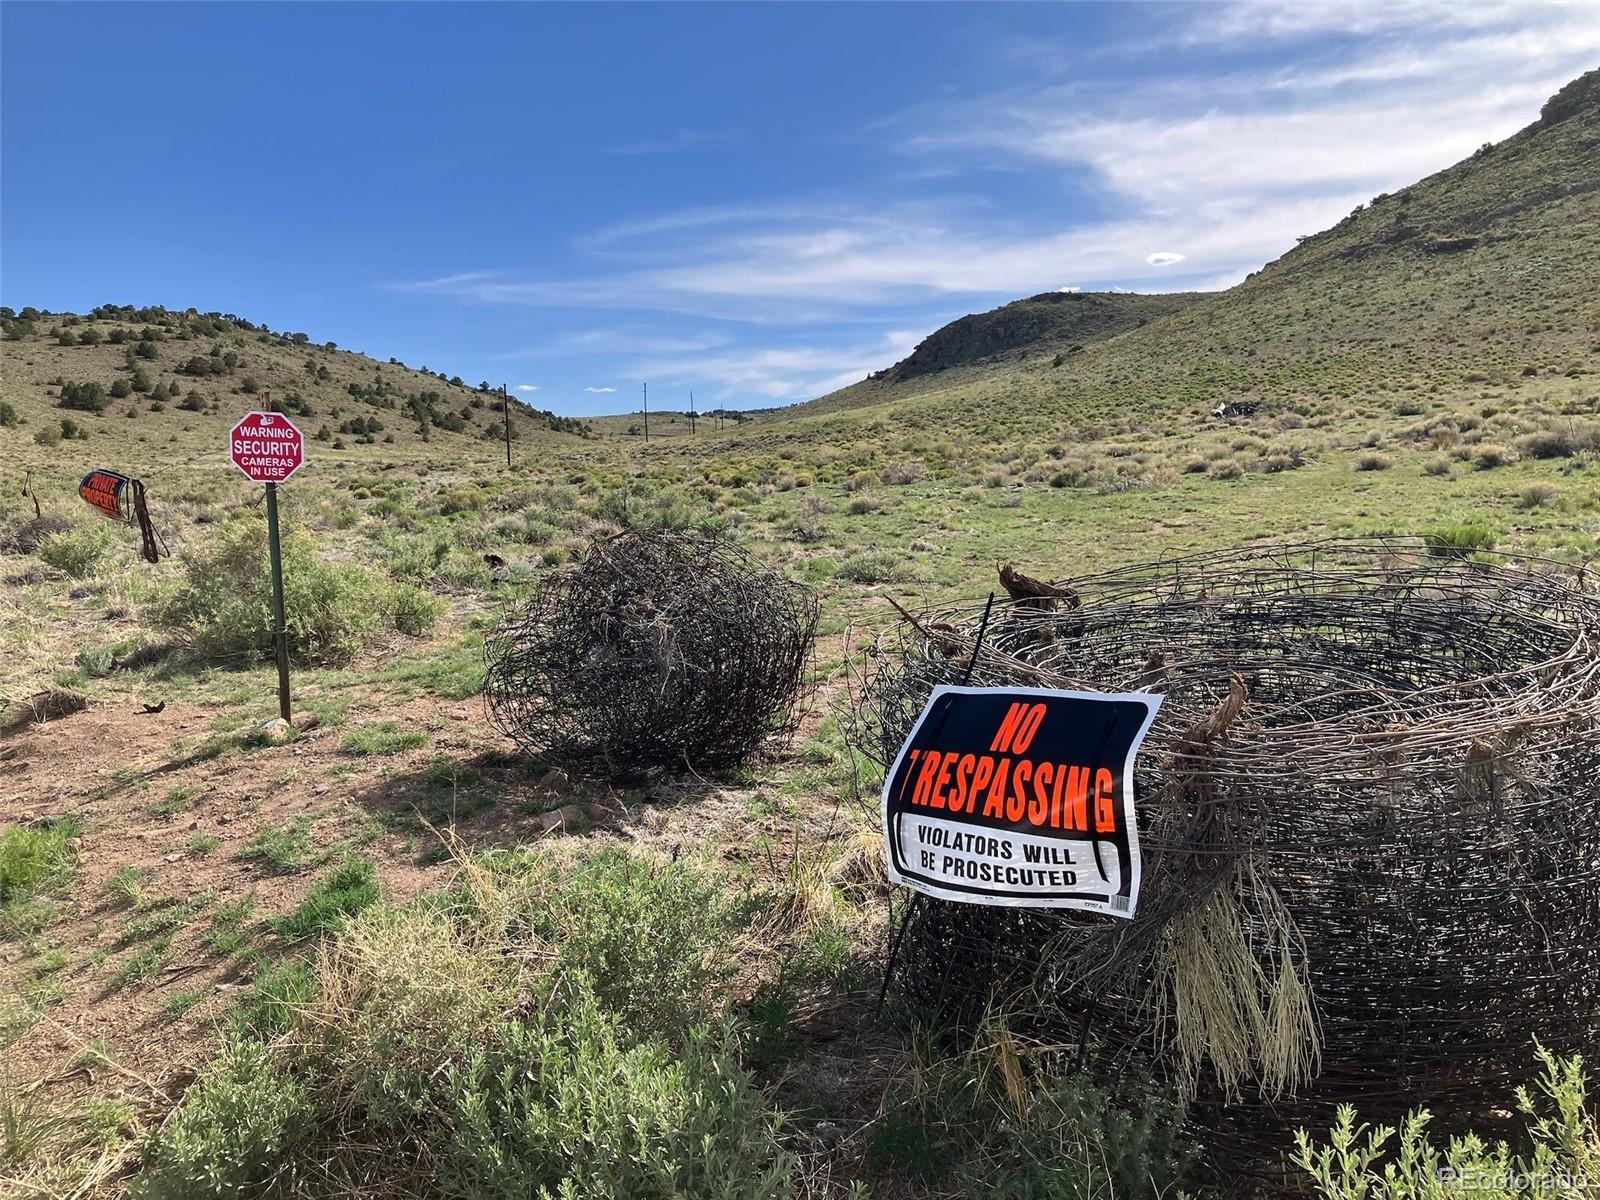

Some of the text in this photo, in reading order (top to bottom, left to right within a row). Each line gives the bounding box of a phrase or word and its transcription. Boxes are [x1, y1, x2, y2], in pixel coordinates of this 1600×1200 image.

[240, 426, 294, 438] WARNING
[234, 440, 299, 456] SECURITY
[241, 457, 294, 467] CAMERAS
[250, 467, 285, 476] IN USE
[81, 486, 118, 511] PROPERTY
[990, 702, 1047, 755] NO
[918, 825, 1077, 865] VIOLATORS WILL
[921, 850, 935, 871] BE
[943, 856, 1077, 886] PROSECUTED
